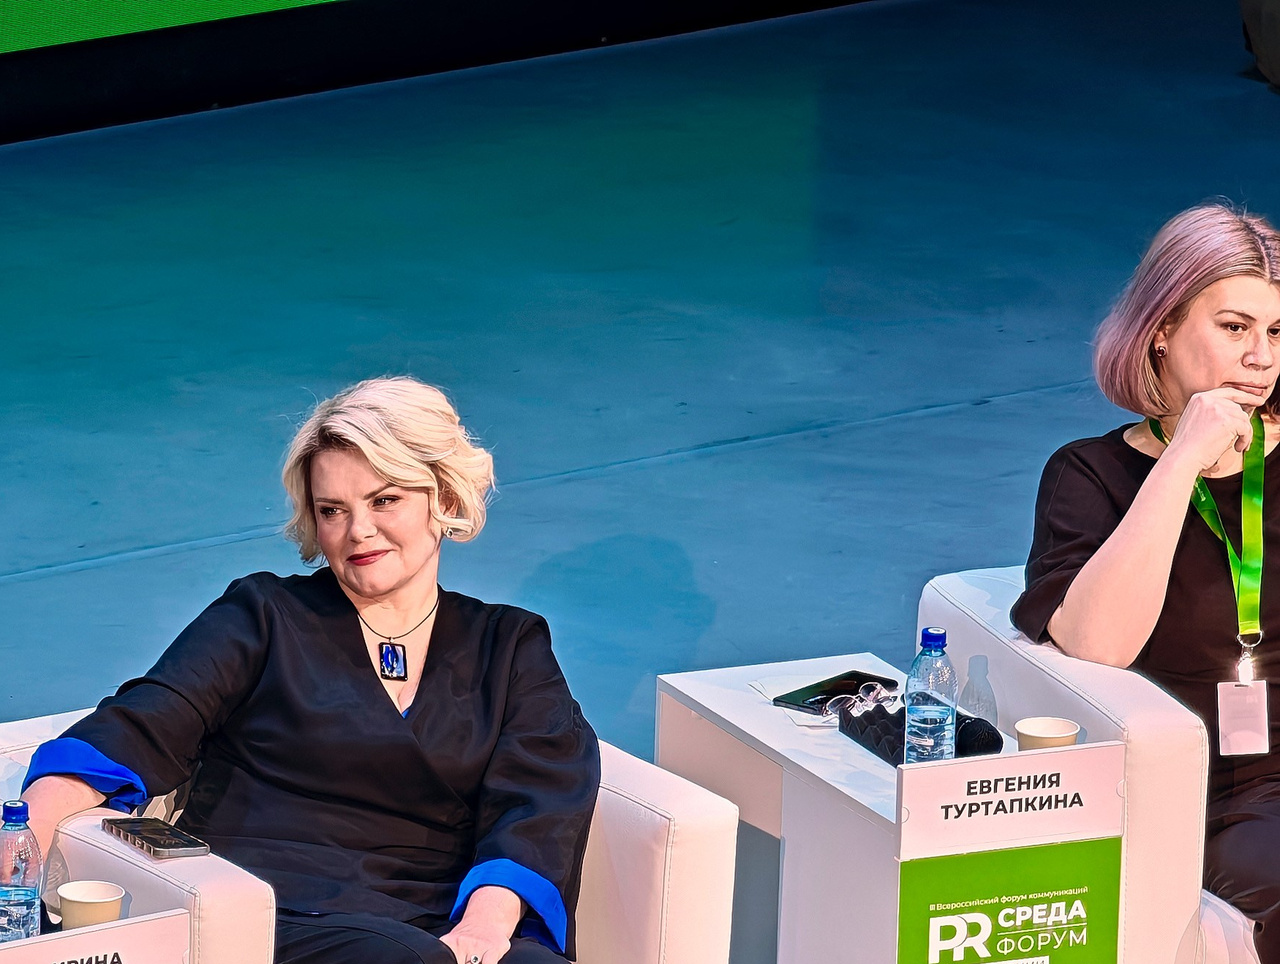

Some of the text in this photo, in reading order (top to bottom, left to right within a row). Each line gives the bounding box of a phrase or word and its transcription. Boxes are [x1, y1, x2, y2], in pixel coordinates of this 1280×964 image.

[966, 772, 1061, 796] ЕВГЕНИЯ
[941, 792, 1084, 820] ТУРТАПКИНА
[936, 896, 999, 912] Всероссийский
[1000, 893, 1027, 904] форум
[1028, 886, 1088, 899] коммуникаций
[997, 899, 1087, 928] СРЕДА
[928, 912, 992, 964] PR
[997, 927, 1087, 955] ФОРУМ
